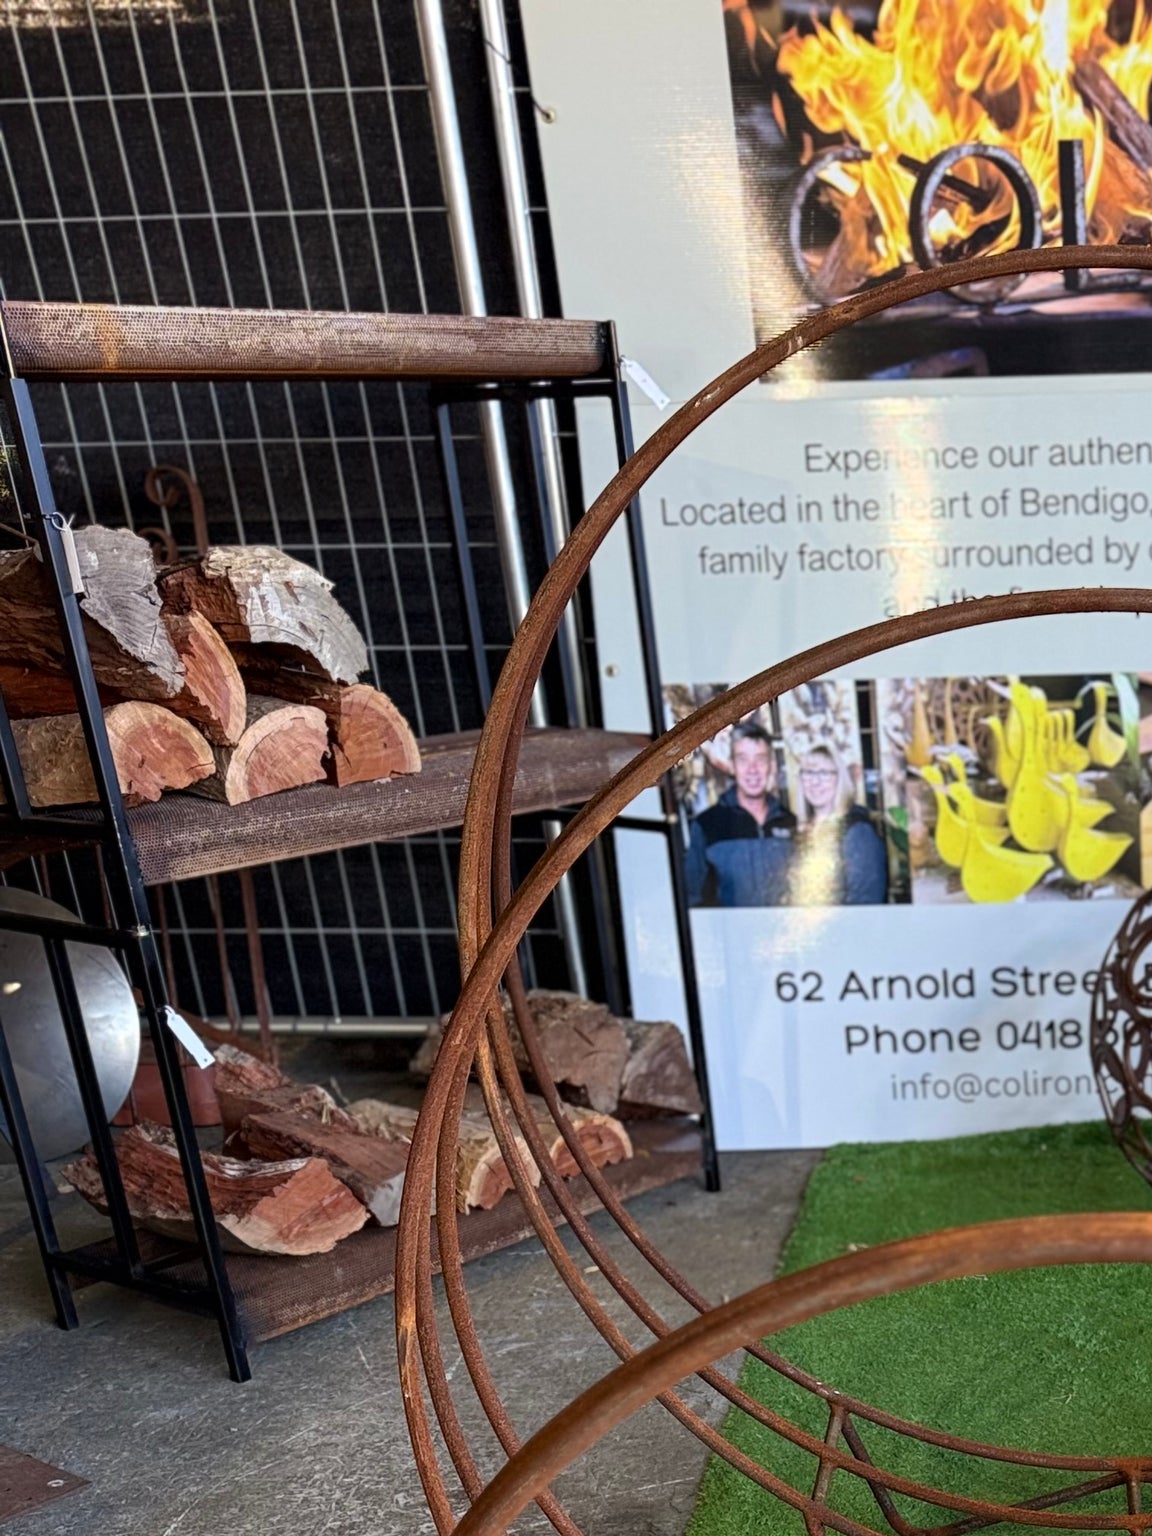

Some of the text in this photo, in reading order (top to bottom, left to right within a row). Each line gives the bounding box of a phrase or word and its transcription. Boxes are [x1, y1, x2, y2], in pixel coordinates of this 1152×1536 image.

[988, 443, 1039, 468] our
[661, 496, 786, 527] Located
[797, 495, 823, 523] in
[832, 492, 880, 521] the
[981, 489, 1011, 518] of
[699, 545, 788, 580] family
[1104, 534, 1140, 570] by
[775, 970, 825, 1002] 62
[839, 968, 976, 1000] Arnold
[990, 965, 1102, 997] Stree
[845, 1023, 981, 1055] Phone
[995, 1019, 1083, 1052] 0418
